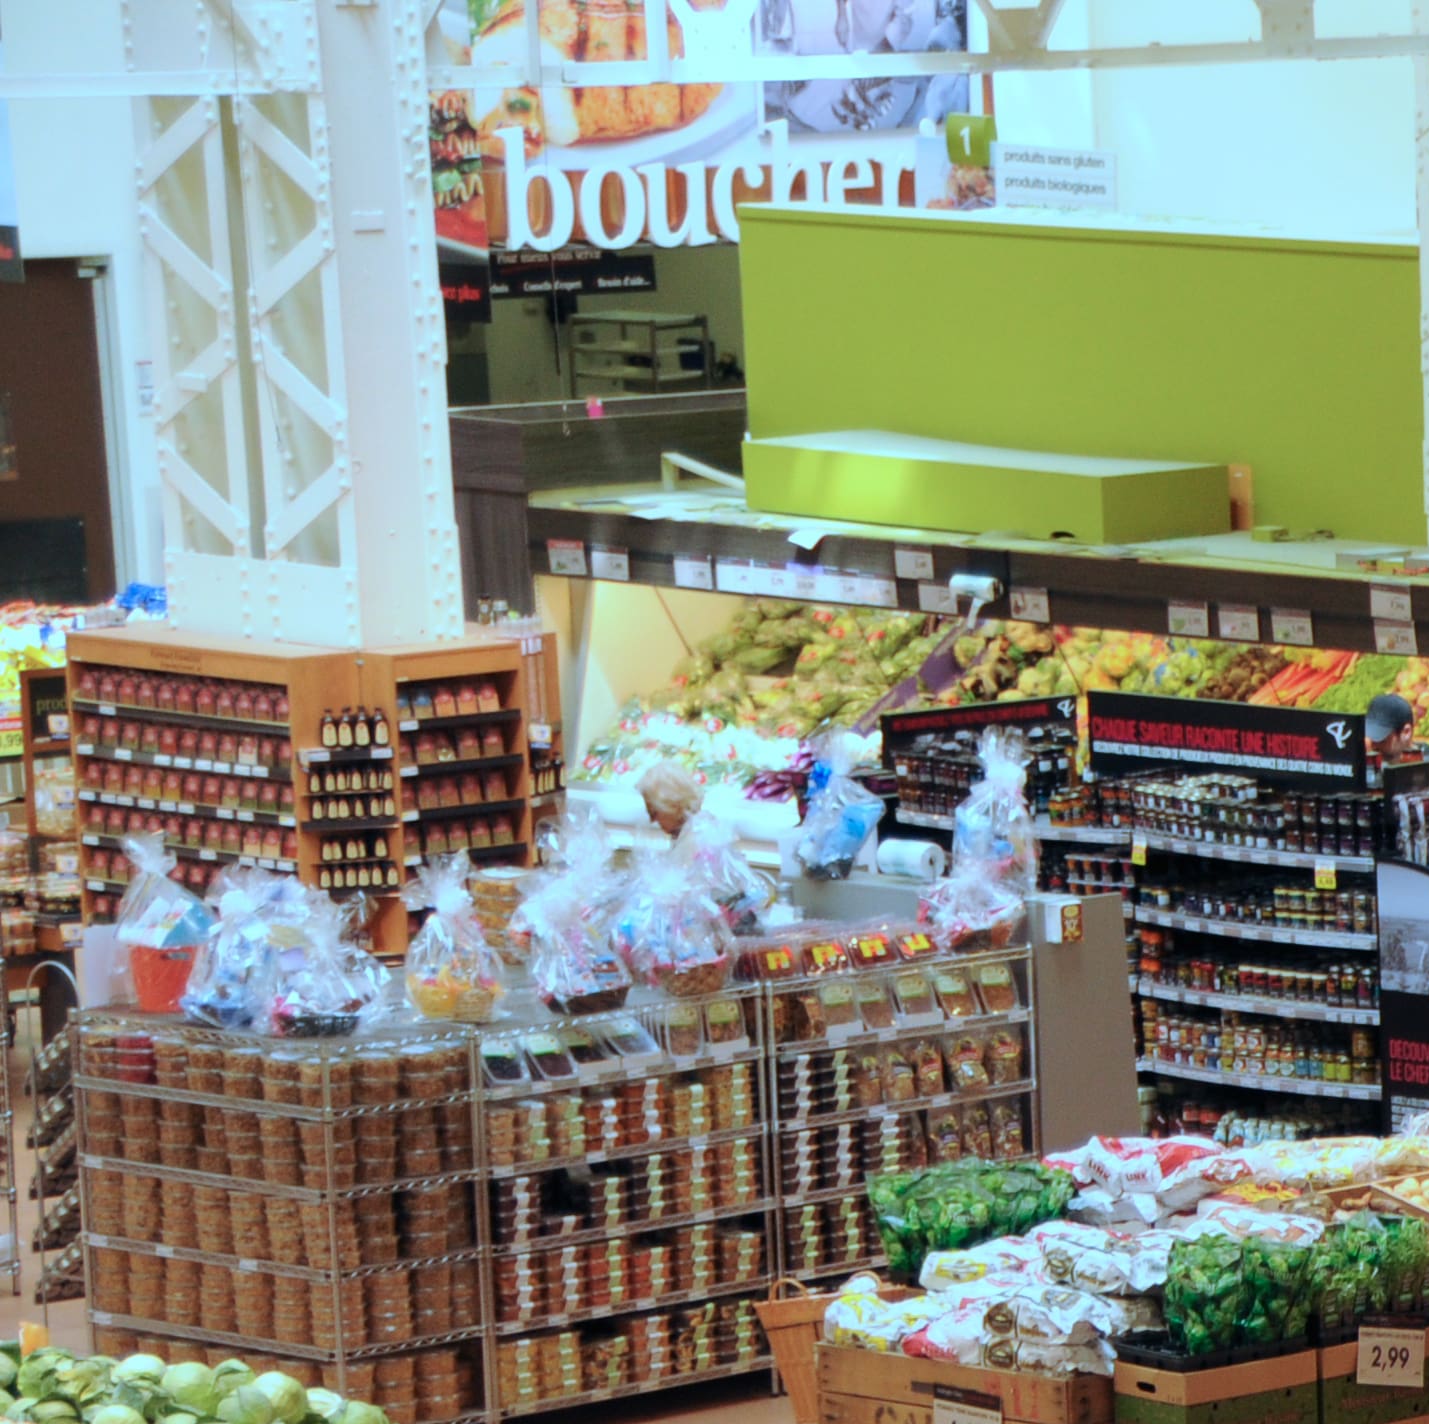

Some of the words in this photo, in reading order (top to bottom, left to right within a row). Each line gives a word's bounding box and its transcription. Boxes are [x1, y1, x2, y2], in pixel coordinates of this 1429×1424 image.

[960, 127, 970, 156] 1
[1004, 151, 1045, 165] produits
[1048, 155, 1071, 167] sans
[1073, 154, 1105, 170] gluten
[1005, 176, 1046, 190] produits
[1048, 178, 1106, 195] biologiques
[1138, 721, 1184, 746] SAVEUR
[1186, 725, 1238, 751] RACONTE
[1241, 730, 1264, 754] UNE
[1390, 1061, 1401, 1082] LE
[1371, 1344, 1410, 1372] 2,99
